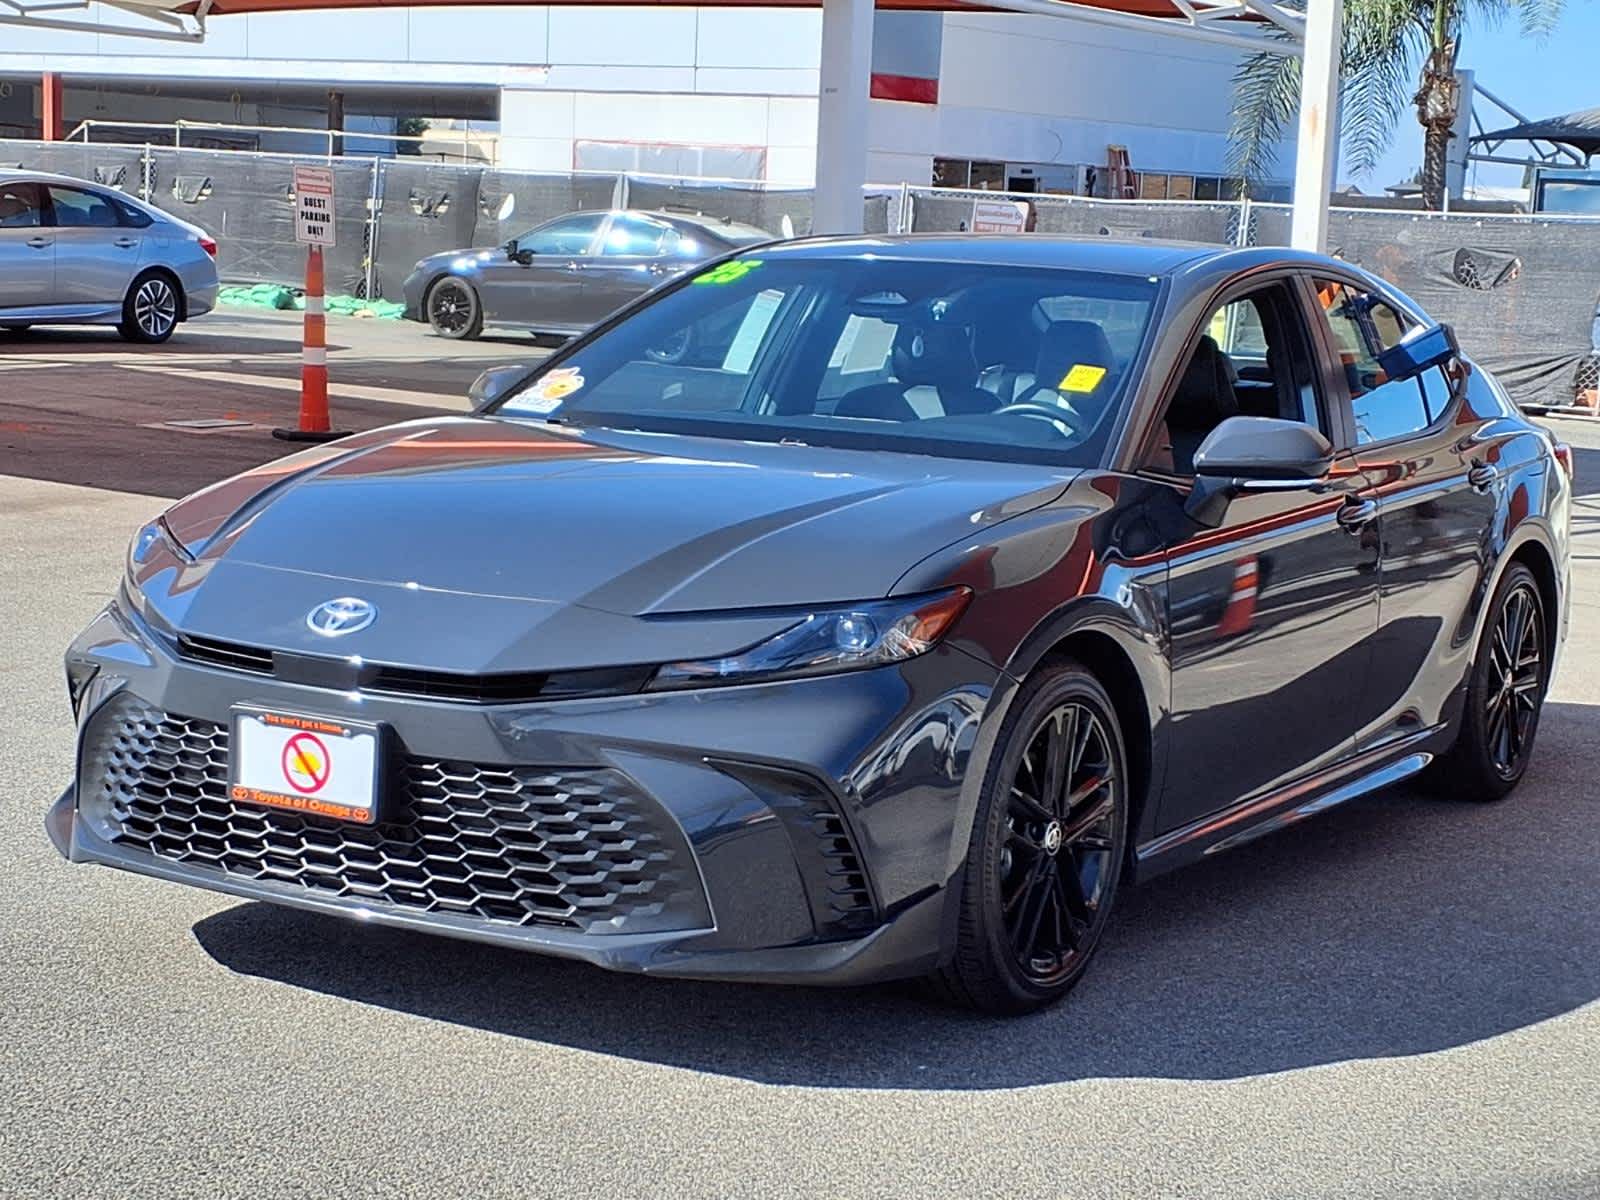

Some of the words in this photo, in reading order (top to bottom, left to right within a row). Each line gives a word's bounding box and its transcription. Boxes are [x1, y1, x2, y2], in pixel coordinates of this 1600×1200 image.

[304, 197, 326, 209] GUEST
[300, 210, 331, 223] PARKING
[307, 225, 324, 236] ONLY
[250, 789, 291, 806] Toyota
[293, 797, 307, 809] of
[308, 800, 351, 818] Orange
